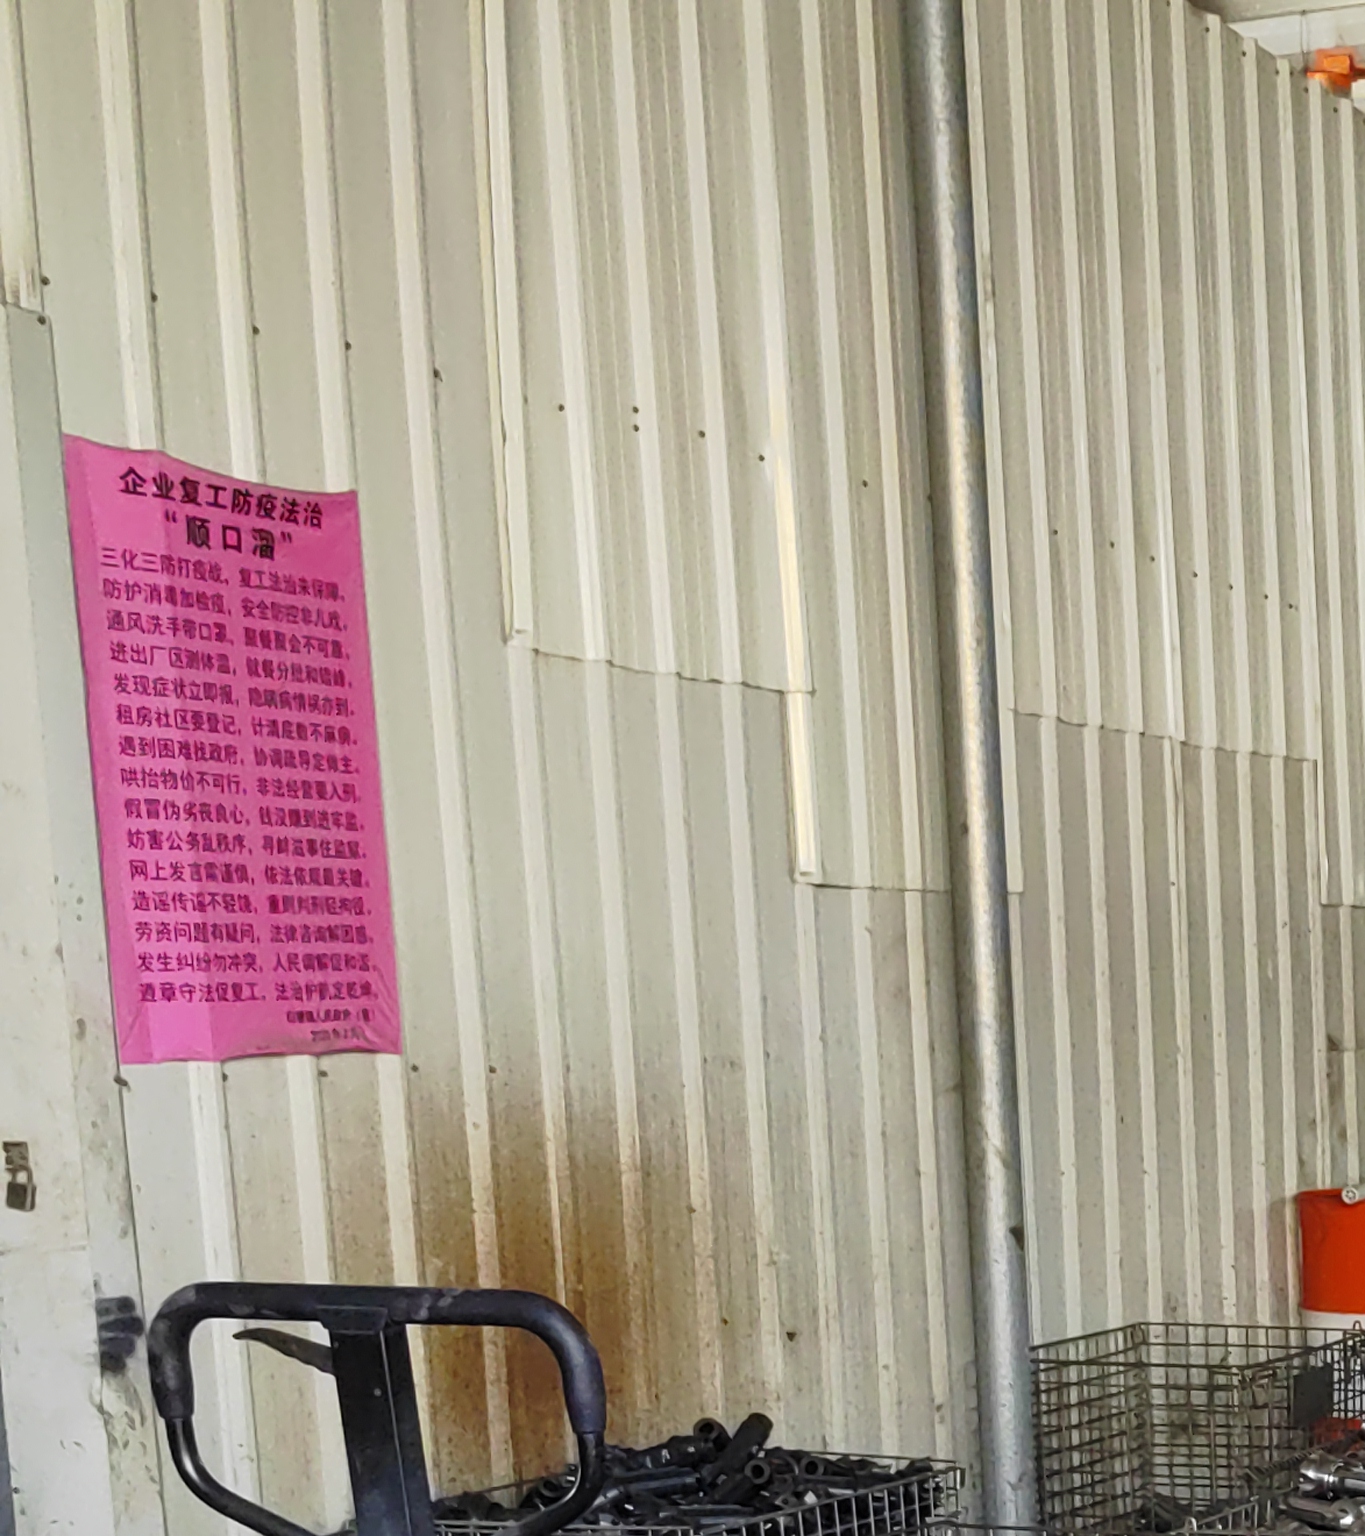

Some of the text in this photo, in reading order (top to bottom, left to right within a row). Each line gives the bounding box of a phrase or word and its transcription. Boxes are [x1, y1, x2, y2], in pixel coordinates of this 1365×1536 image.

[119, 466, 323, 529] 企业复工防疫法治
